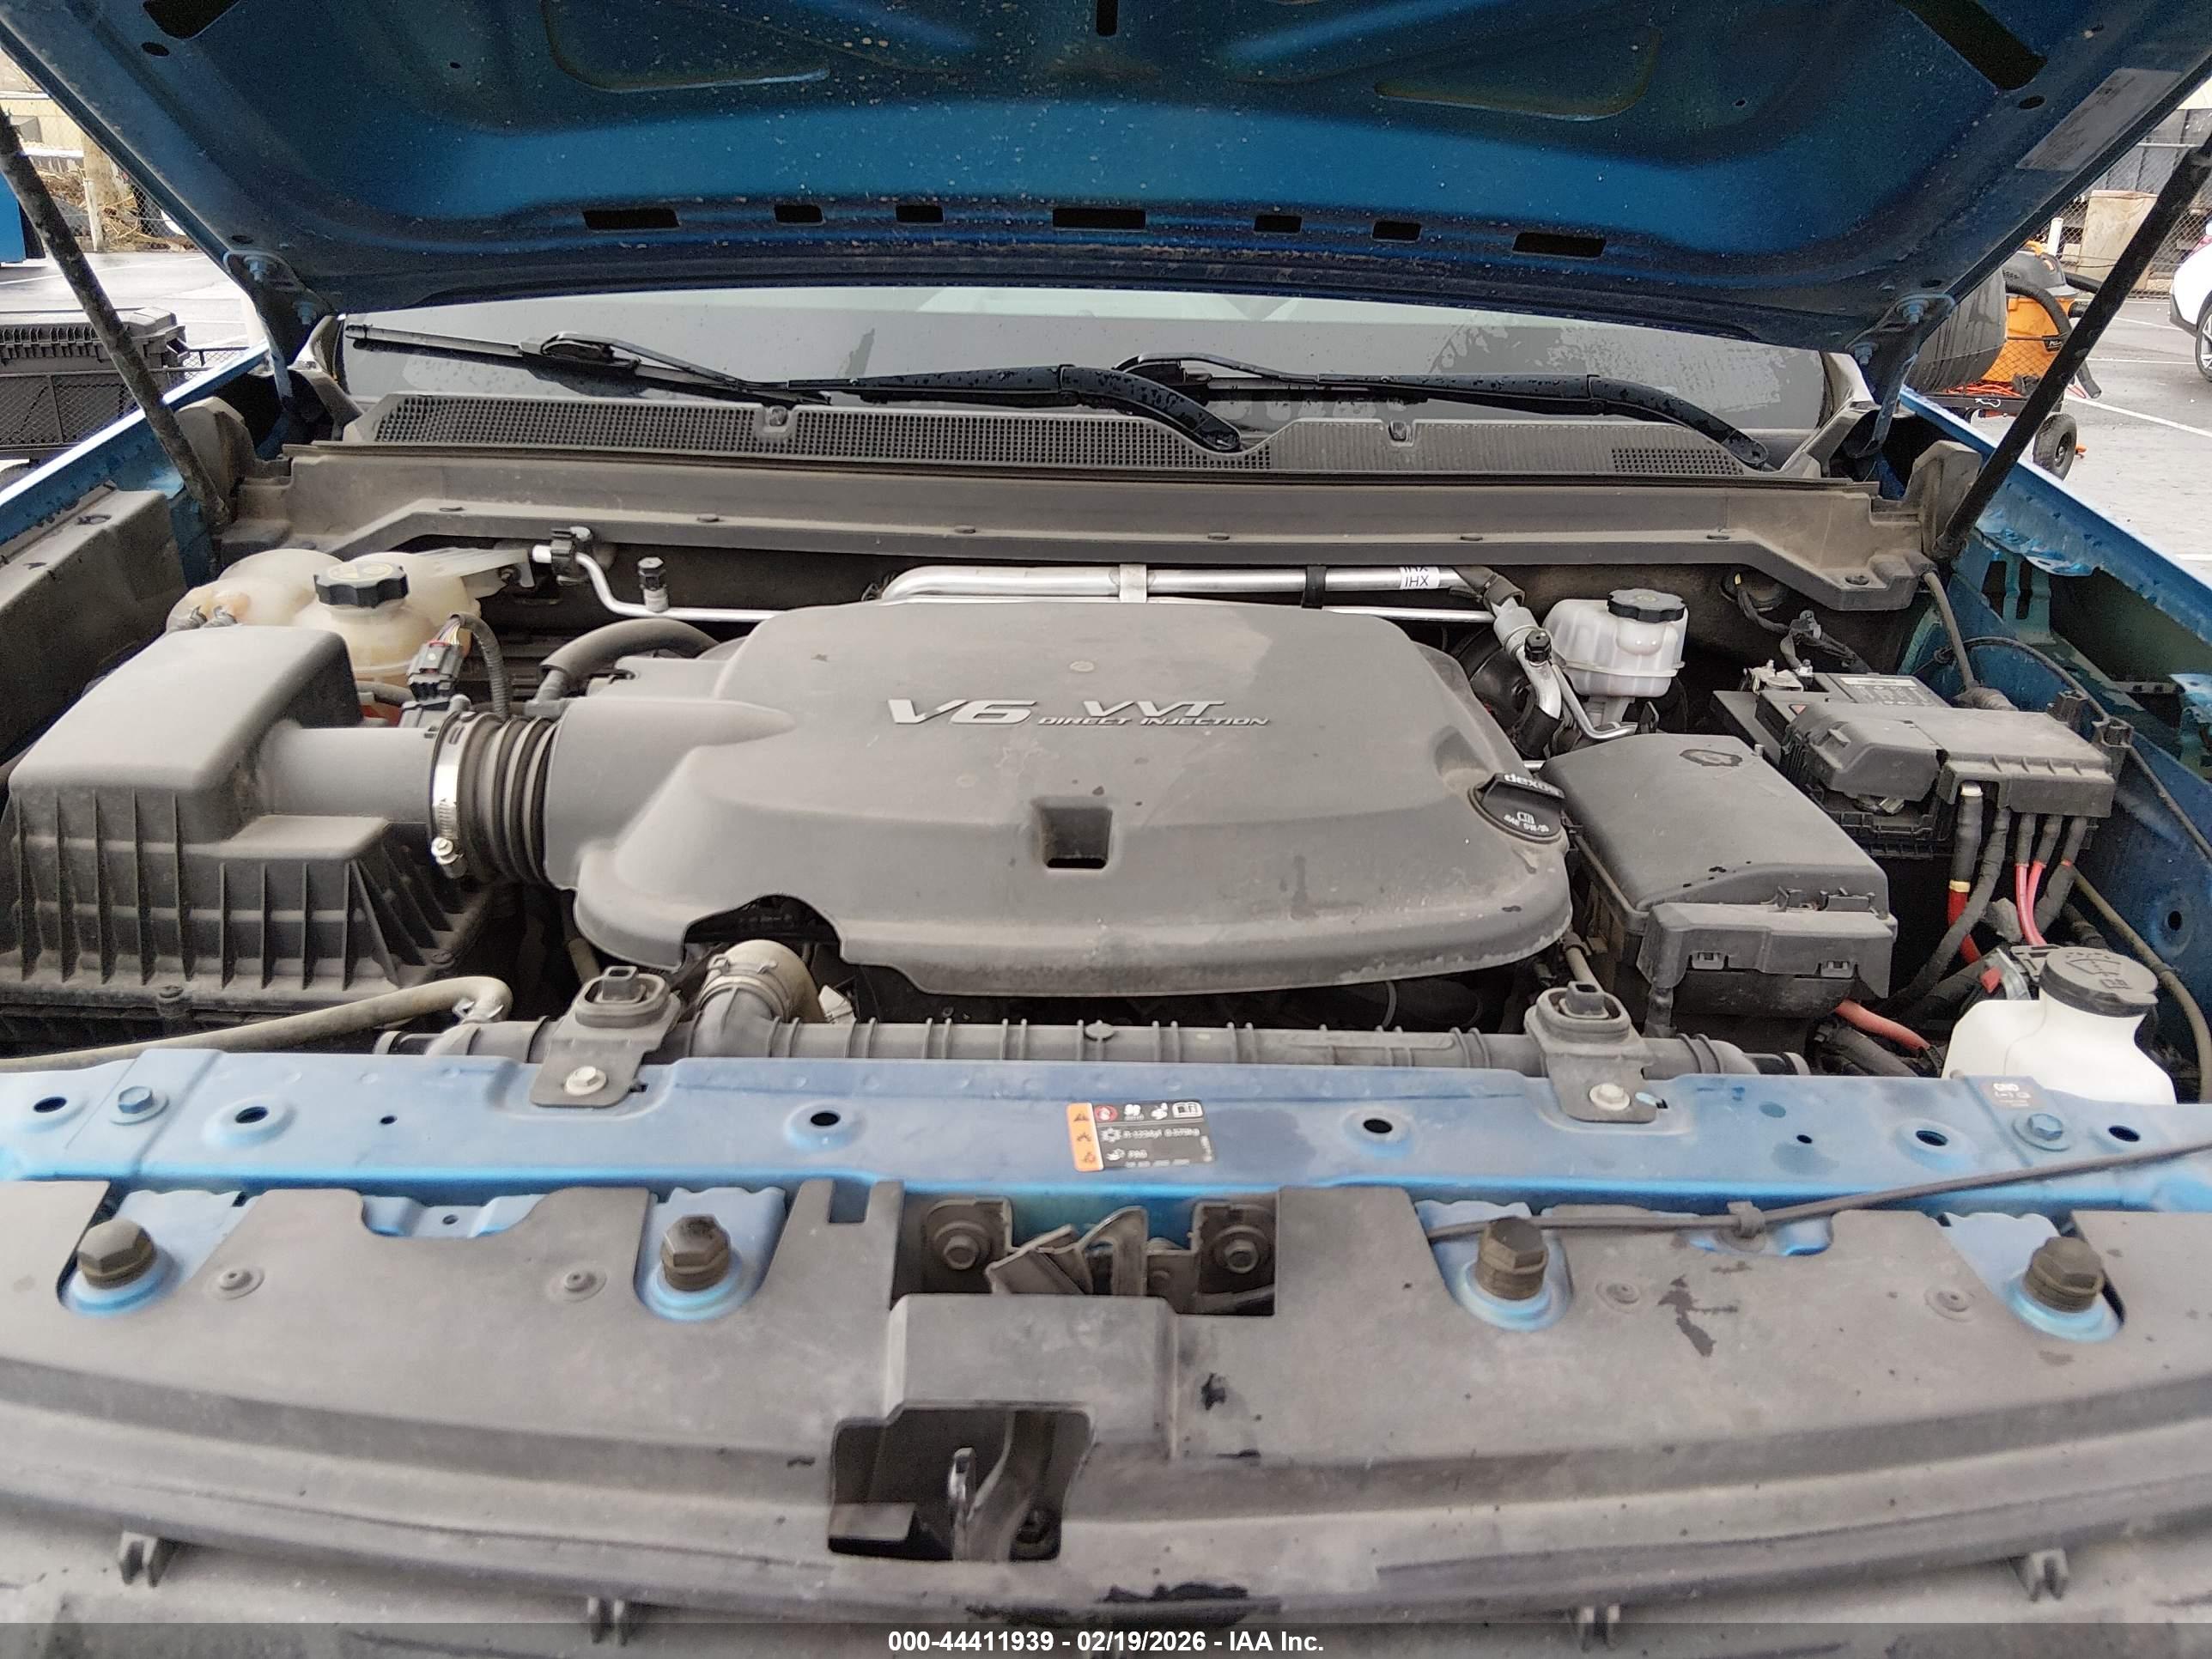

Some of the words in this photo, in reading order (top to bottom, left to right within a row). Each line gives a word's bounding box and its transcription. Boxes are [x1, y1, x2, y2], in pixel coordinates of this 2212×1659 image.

[1405, 575, 1429, 587] IHX
[887, 699, 1036, 725] V6
[1082, 700, 1225, 718] VVT
[1036, 716, 1133, 726] DIRECT
[1139, 716, 1270, 726] INJECTION
